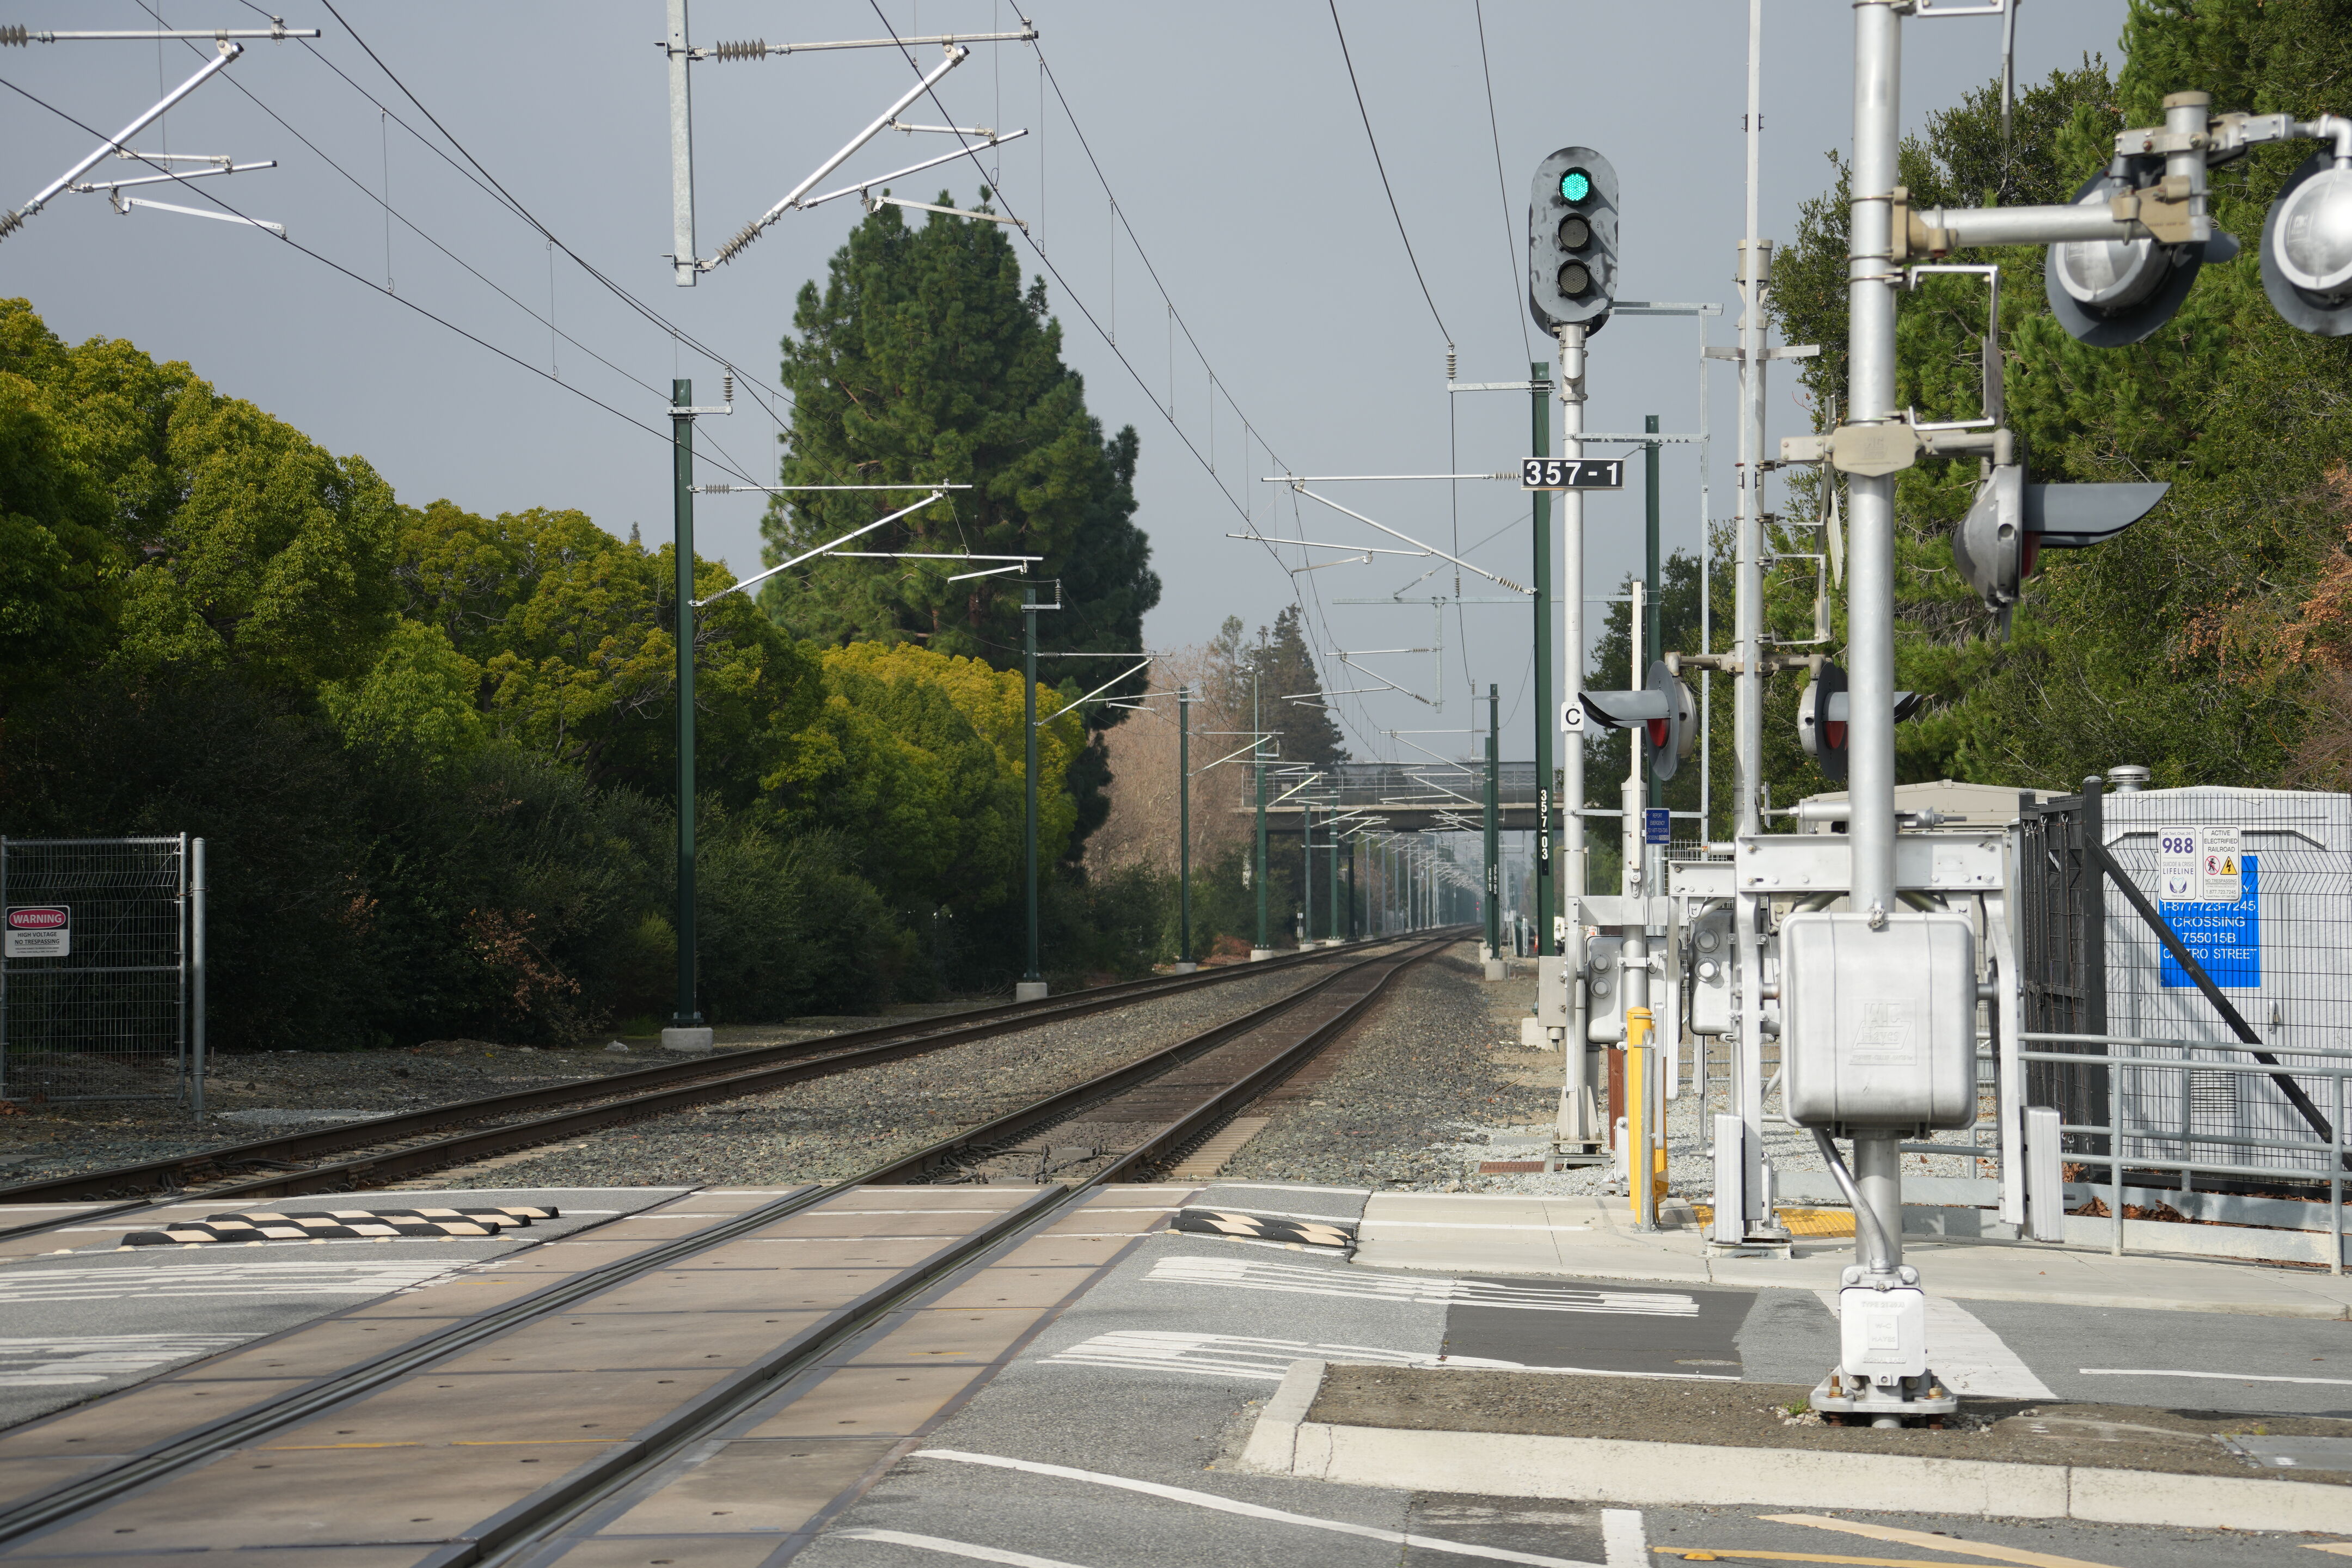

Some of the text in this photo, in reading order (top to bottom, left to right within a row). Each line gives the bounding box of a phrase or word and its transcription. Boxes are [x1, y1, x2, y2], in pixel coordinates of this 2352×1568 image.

[1526, 461, 1618, 485] 357-1
[1566, 708, 1580, 725] C
[2163, 837, 2194, 854] 988
[13, 914, 62, 923] WARNING
[2172, 916, 2245, 927] CROSSING
[2182, 933, 2236, 943] 755015B
[2163, 948, 2257, 959] CRO STREET
